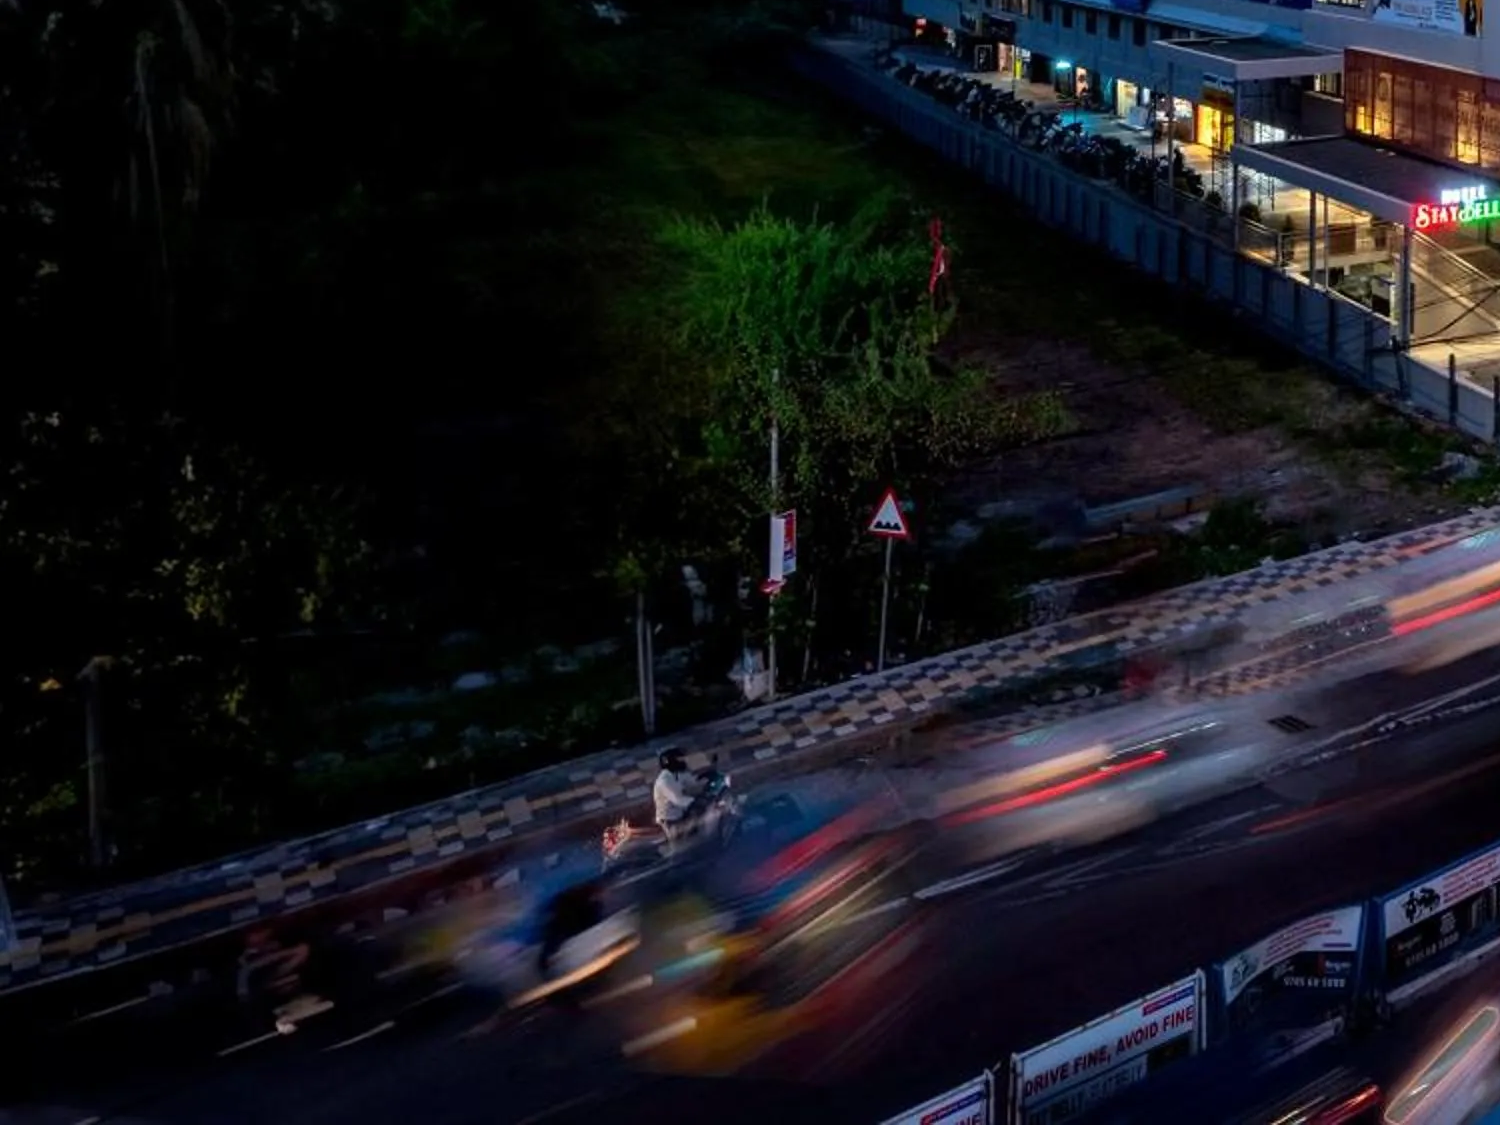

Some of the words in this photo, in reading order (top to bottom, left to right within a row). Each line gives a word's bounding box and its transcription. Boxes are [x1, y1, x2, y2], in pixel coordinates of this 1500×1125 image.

[1024, 1064, 1069, 1098] DRIVE
[1073, 1047, 1112, 1074] FINE,
[1115, 1021, 1160, 1055] AVOID
[1162, 1005, 1195, 1032] FINE
